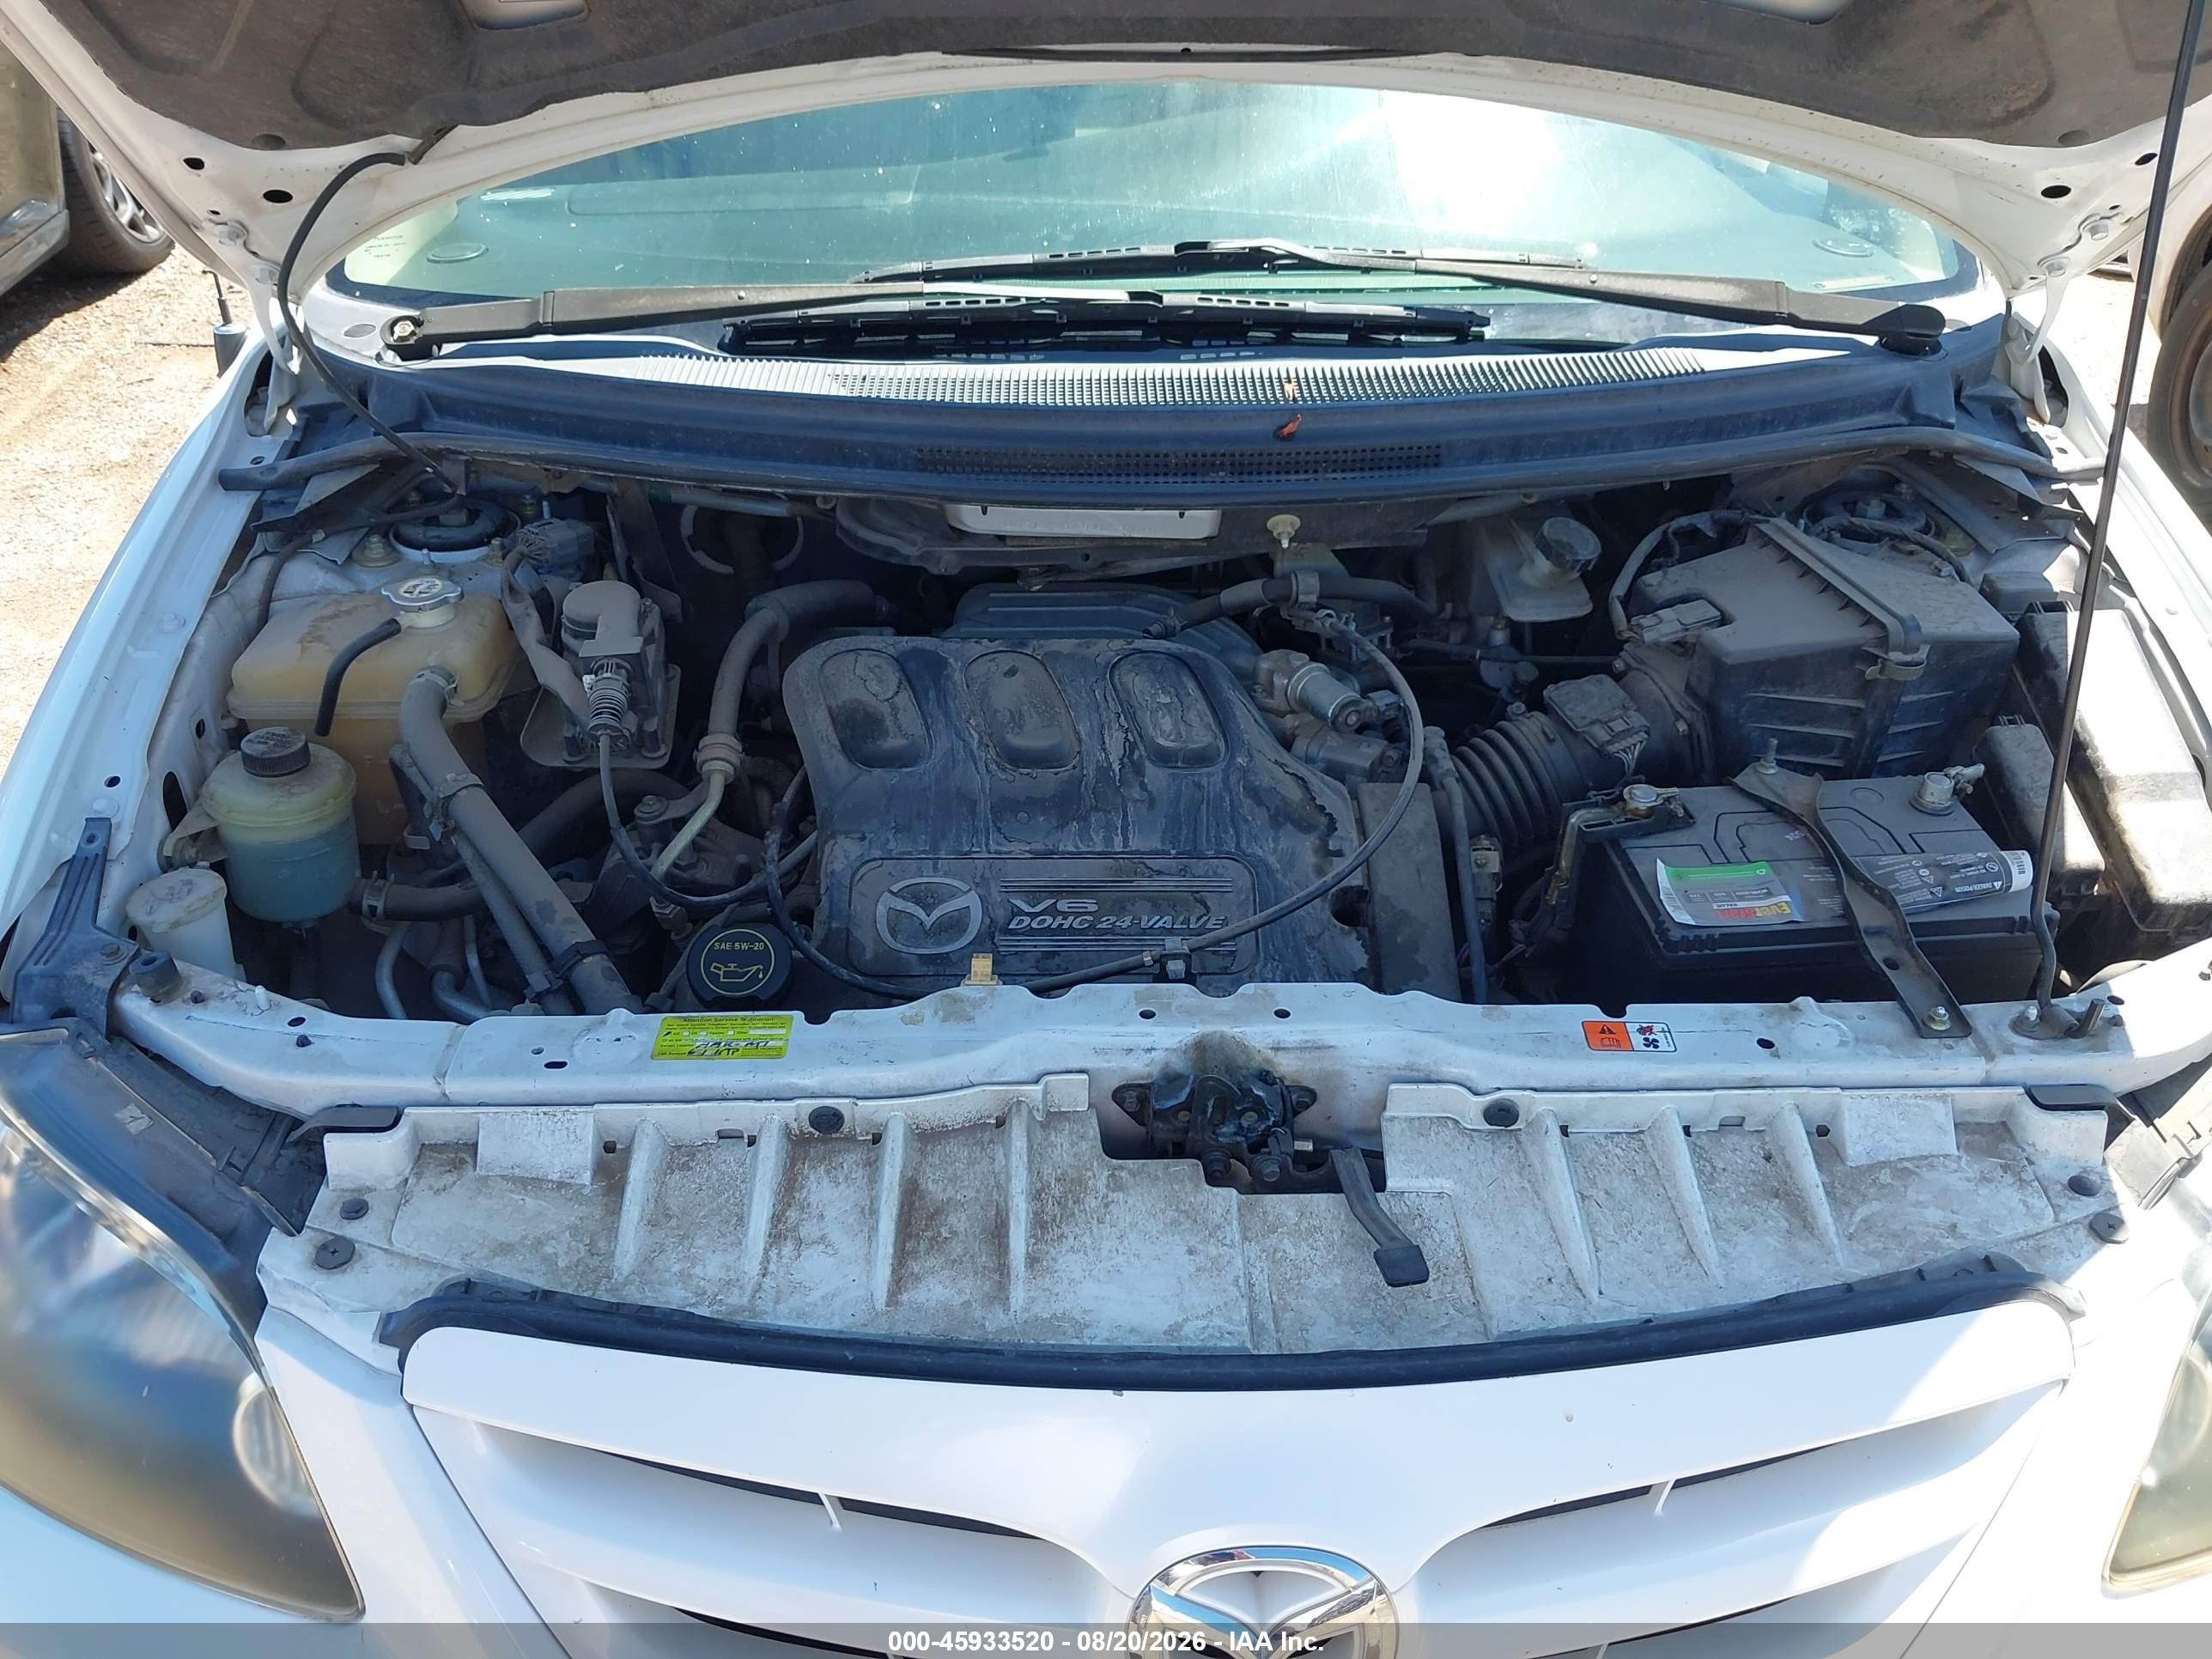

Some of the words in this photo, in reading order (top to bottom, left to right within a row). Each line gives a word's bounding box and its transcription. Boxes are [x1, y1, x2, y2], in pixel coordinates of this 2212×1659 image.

[1009, 898, 1099, 913] V6
[1007, 915, 1095, 930] DOHC
[1095, 915, 1226, 930] 24-VALVE
[714, 941, 732, 951] SAE
[734, 941, 764, 951] 5W-20
